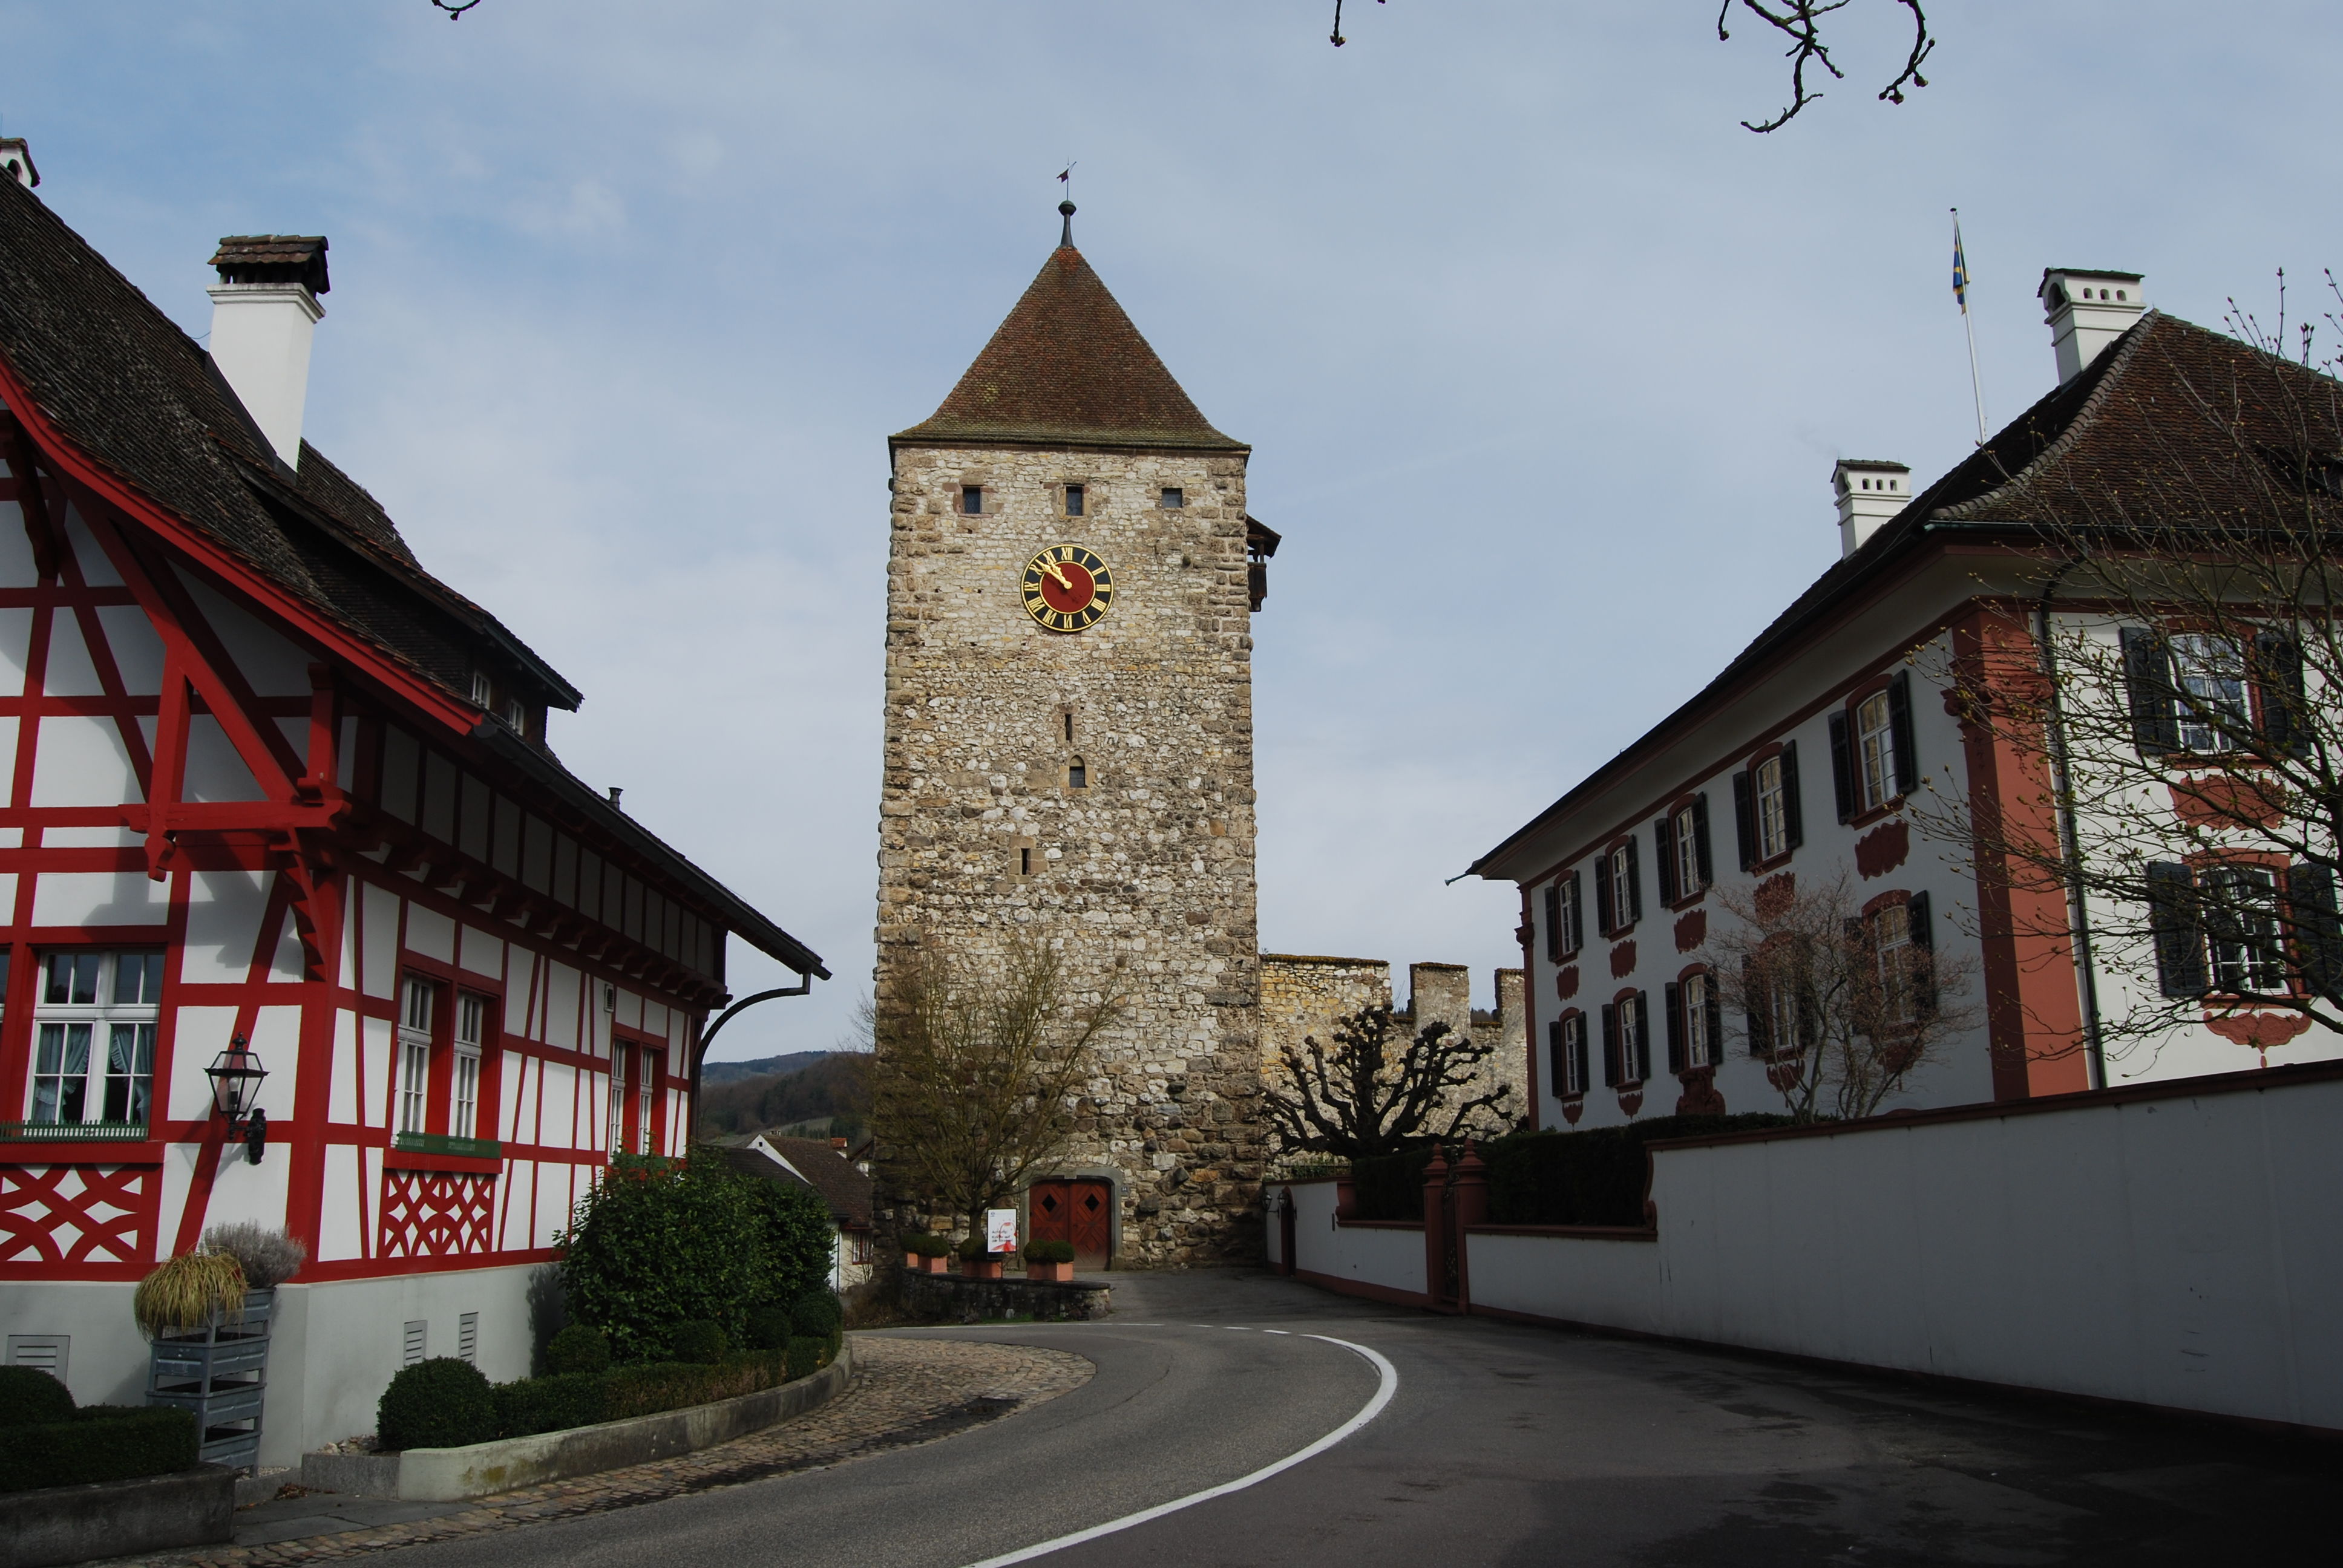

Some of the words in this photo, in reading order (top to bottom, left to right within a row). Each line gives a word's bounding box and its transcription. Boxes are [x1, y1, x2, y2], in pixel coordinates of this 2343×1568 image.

[1061, 547, 1073, 560] XII
[1081, 553, 1090, 564] I
[1092, 566, 1106, 576] II
[1024, 581, 1039, 591] IX
[1027, 596, 1045, 613] VIII
[1091, 598, 1107, 612] IIII
[1043, 610, 1057, 625] VII
[1063, 615, 1073, 629] VI
[1083, 611, 1091, 624] V
